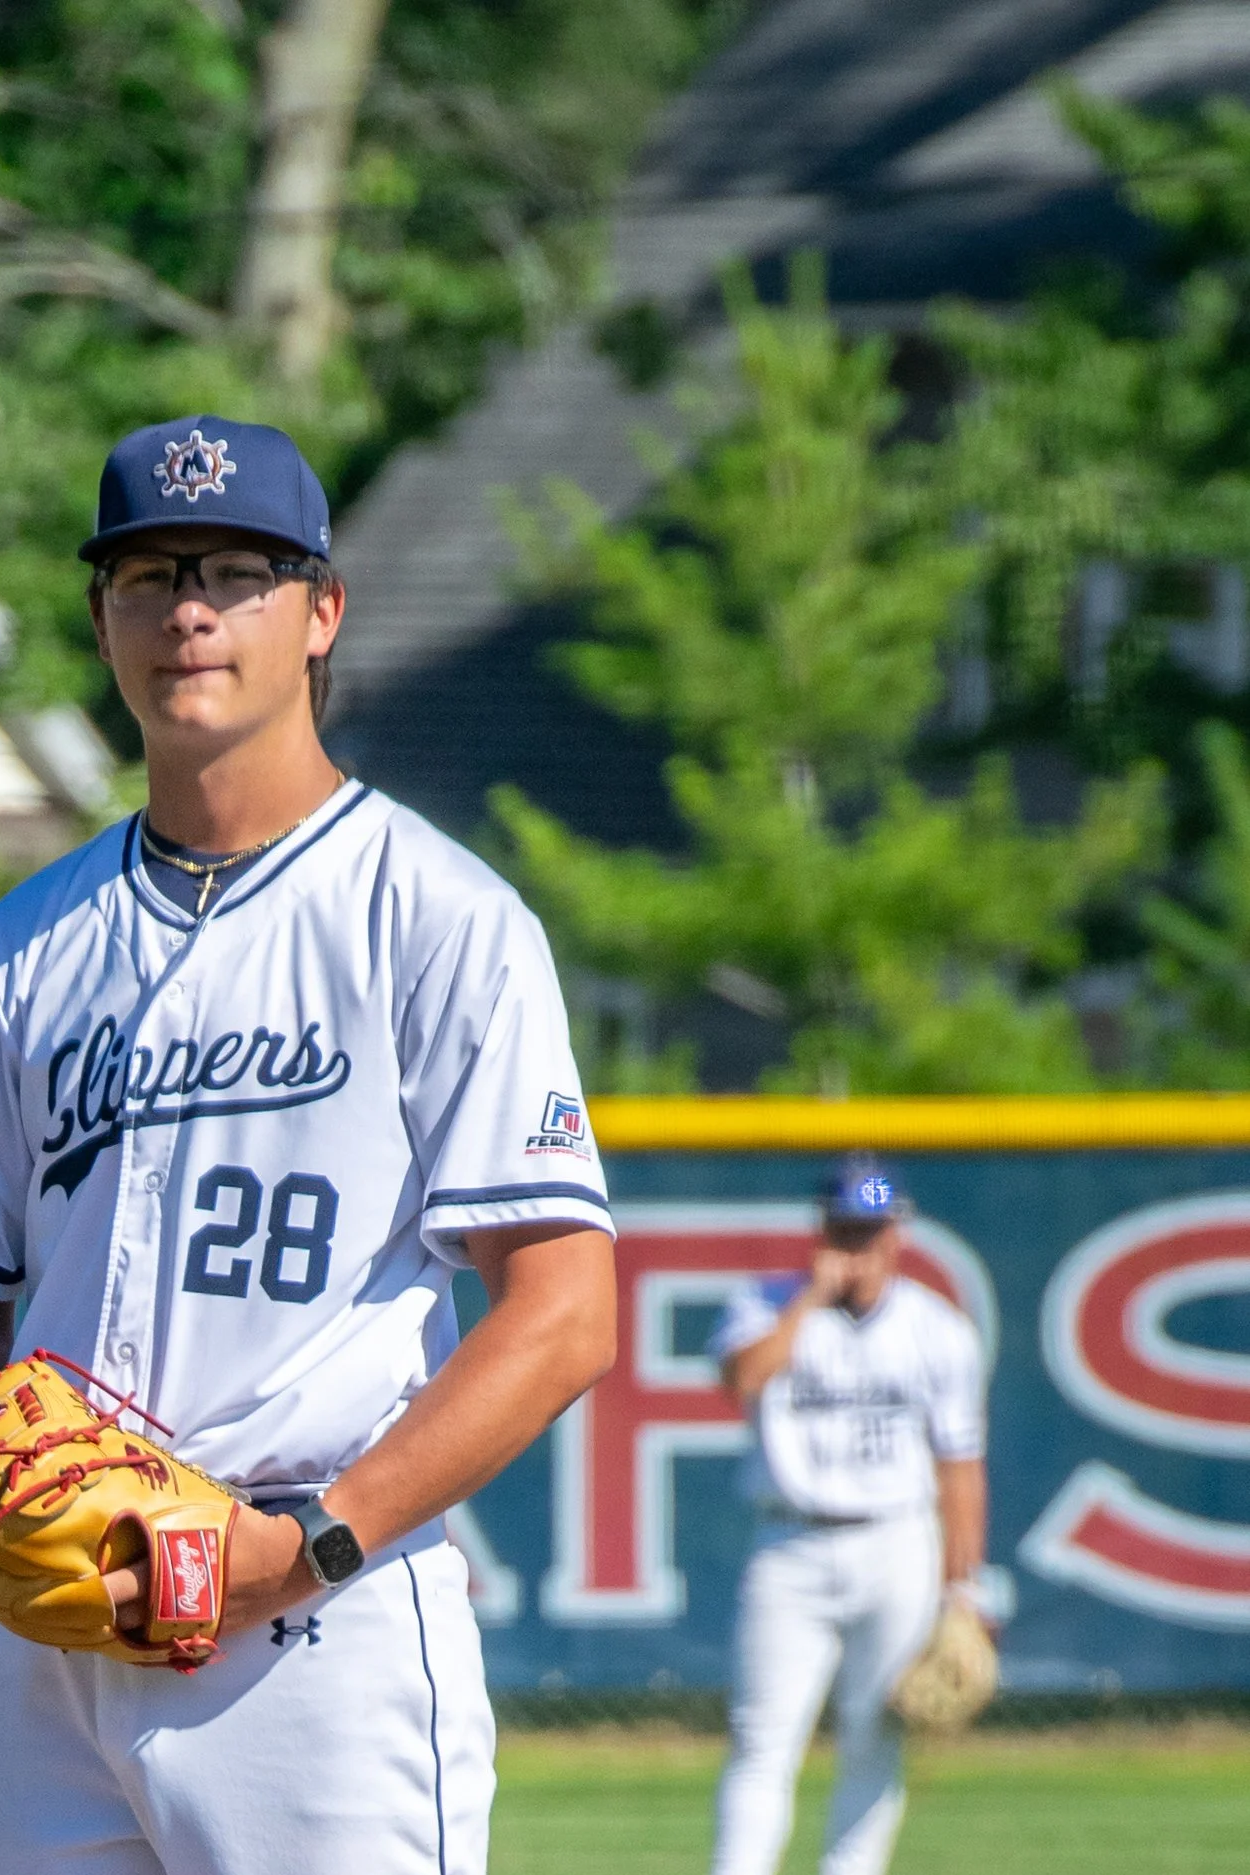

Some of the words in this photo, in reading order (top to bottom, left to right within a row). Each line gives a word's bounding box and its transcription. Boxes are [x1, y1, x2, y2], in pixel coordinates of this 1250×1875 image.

[41, 1013, 351, 1153] Clippers
[182, 1163, 340, 1304] 28
[175, 1535, 207, 1614] Rawlings
